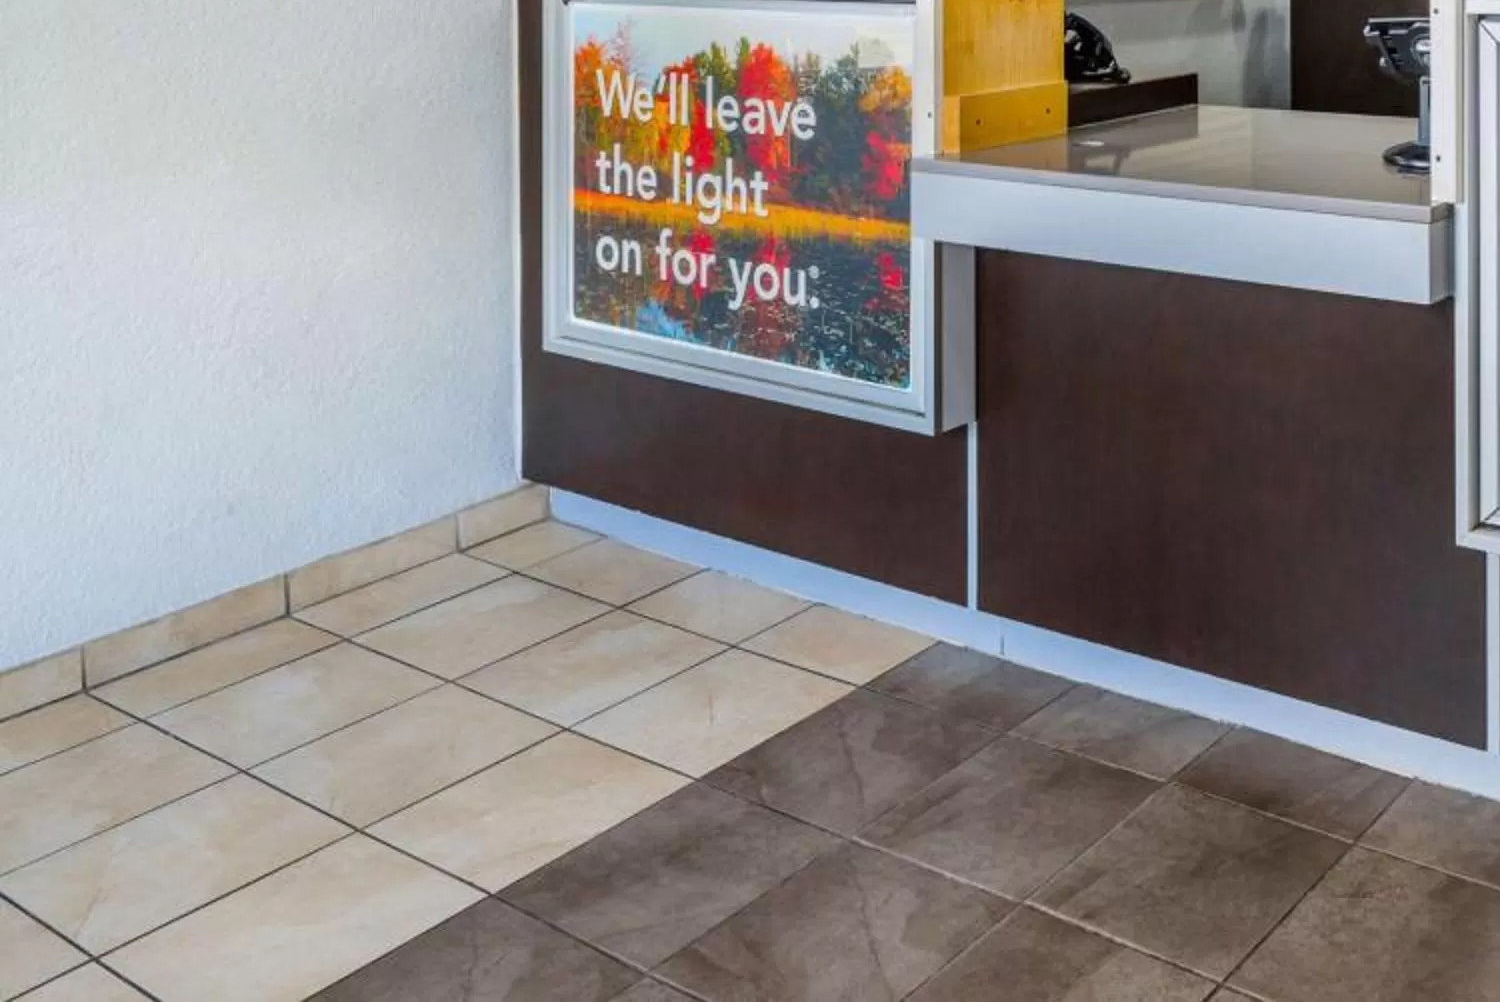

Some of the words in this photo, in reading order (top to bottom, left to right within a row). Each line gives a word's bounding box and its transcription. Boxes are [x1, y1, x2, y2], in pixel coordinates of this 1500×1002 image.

[596, 69, 690, 127] We'll
[705, 75, 817, 140] leave
[595, 142, 658, 200] the
[672, 150, 769, 225] light
[595, 235, 642, 277] on
[655, 228, 717, 289] for
